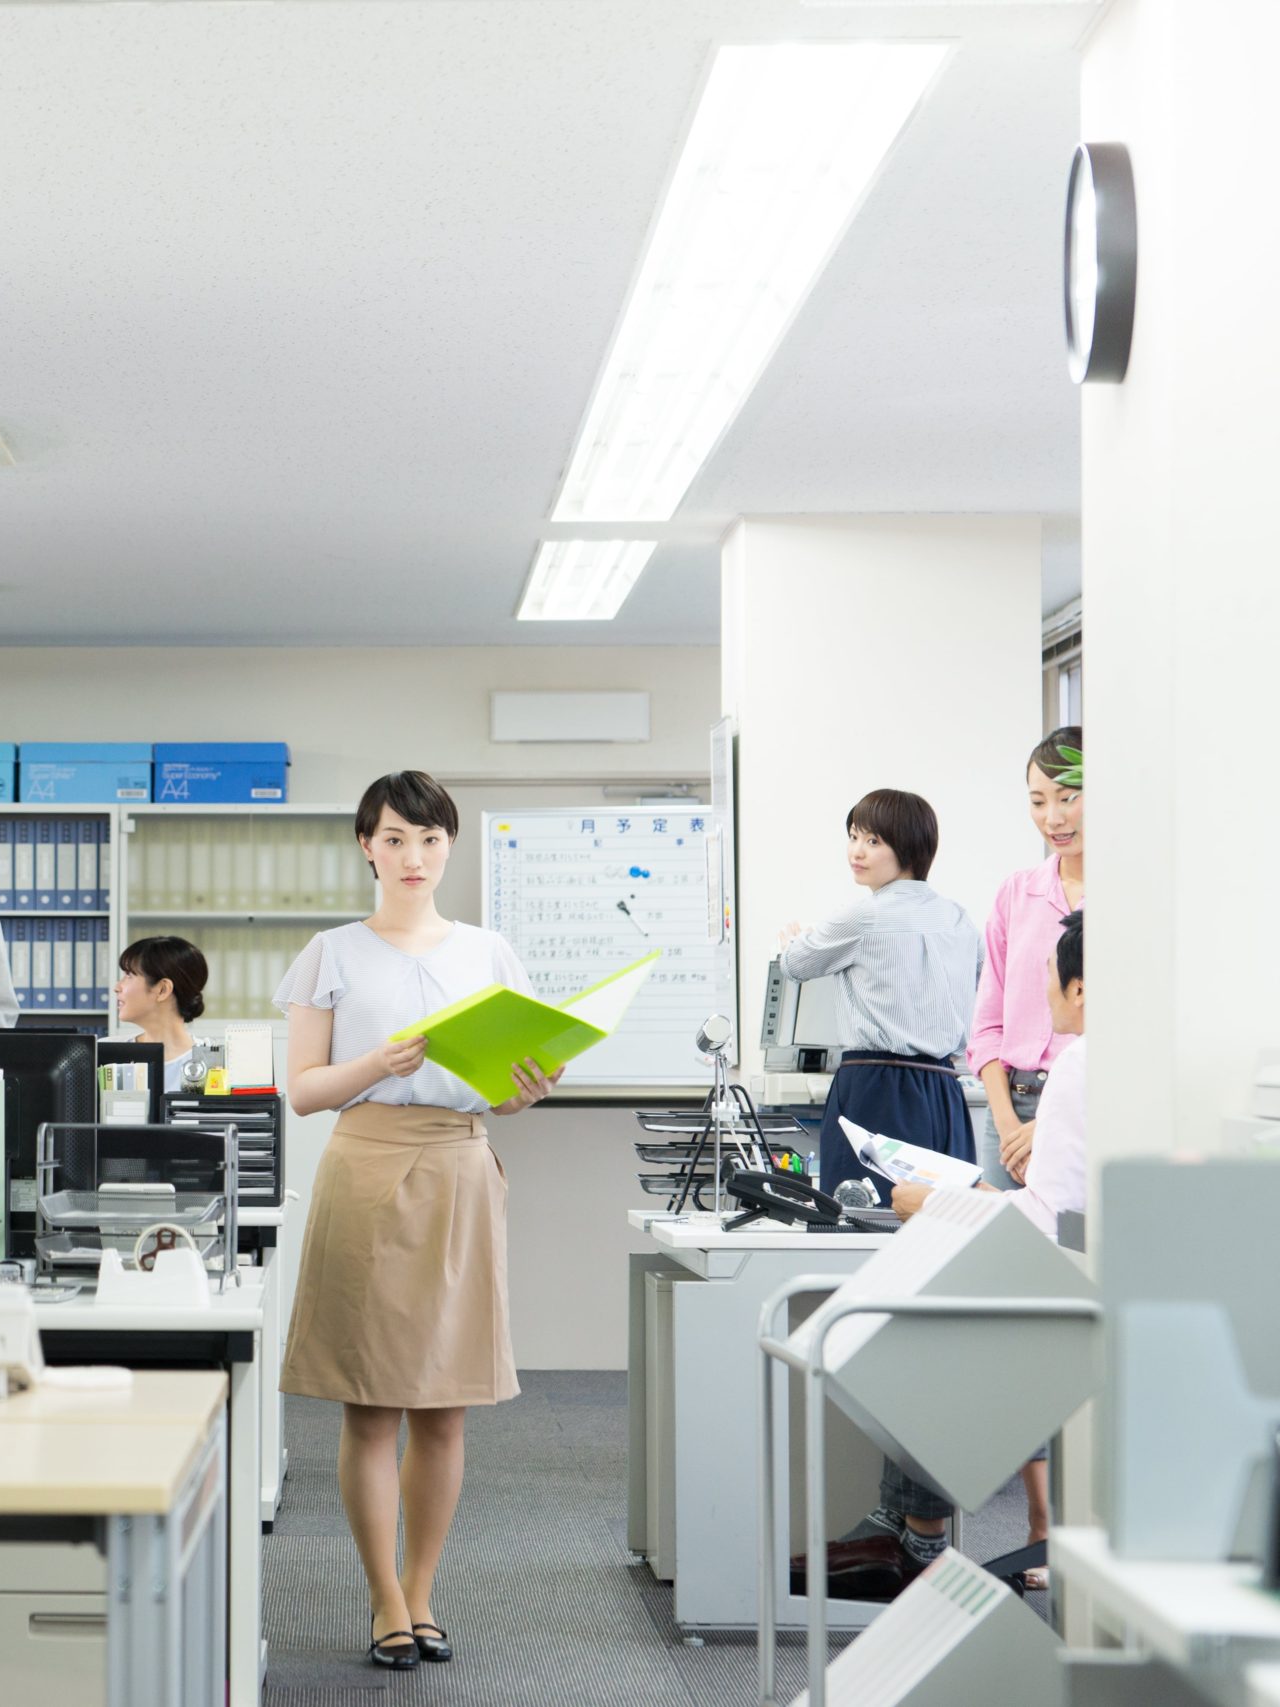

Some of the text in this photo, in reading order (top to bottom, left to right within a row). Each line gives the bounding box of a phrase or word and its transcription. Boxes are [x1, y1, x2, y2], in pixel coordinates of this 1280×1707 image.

[27, 780, 56, 799] A4
[161, 779, 190, 799] A4
[581, 818, 705, 833] 月予定表
